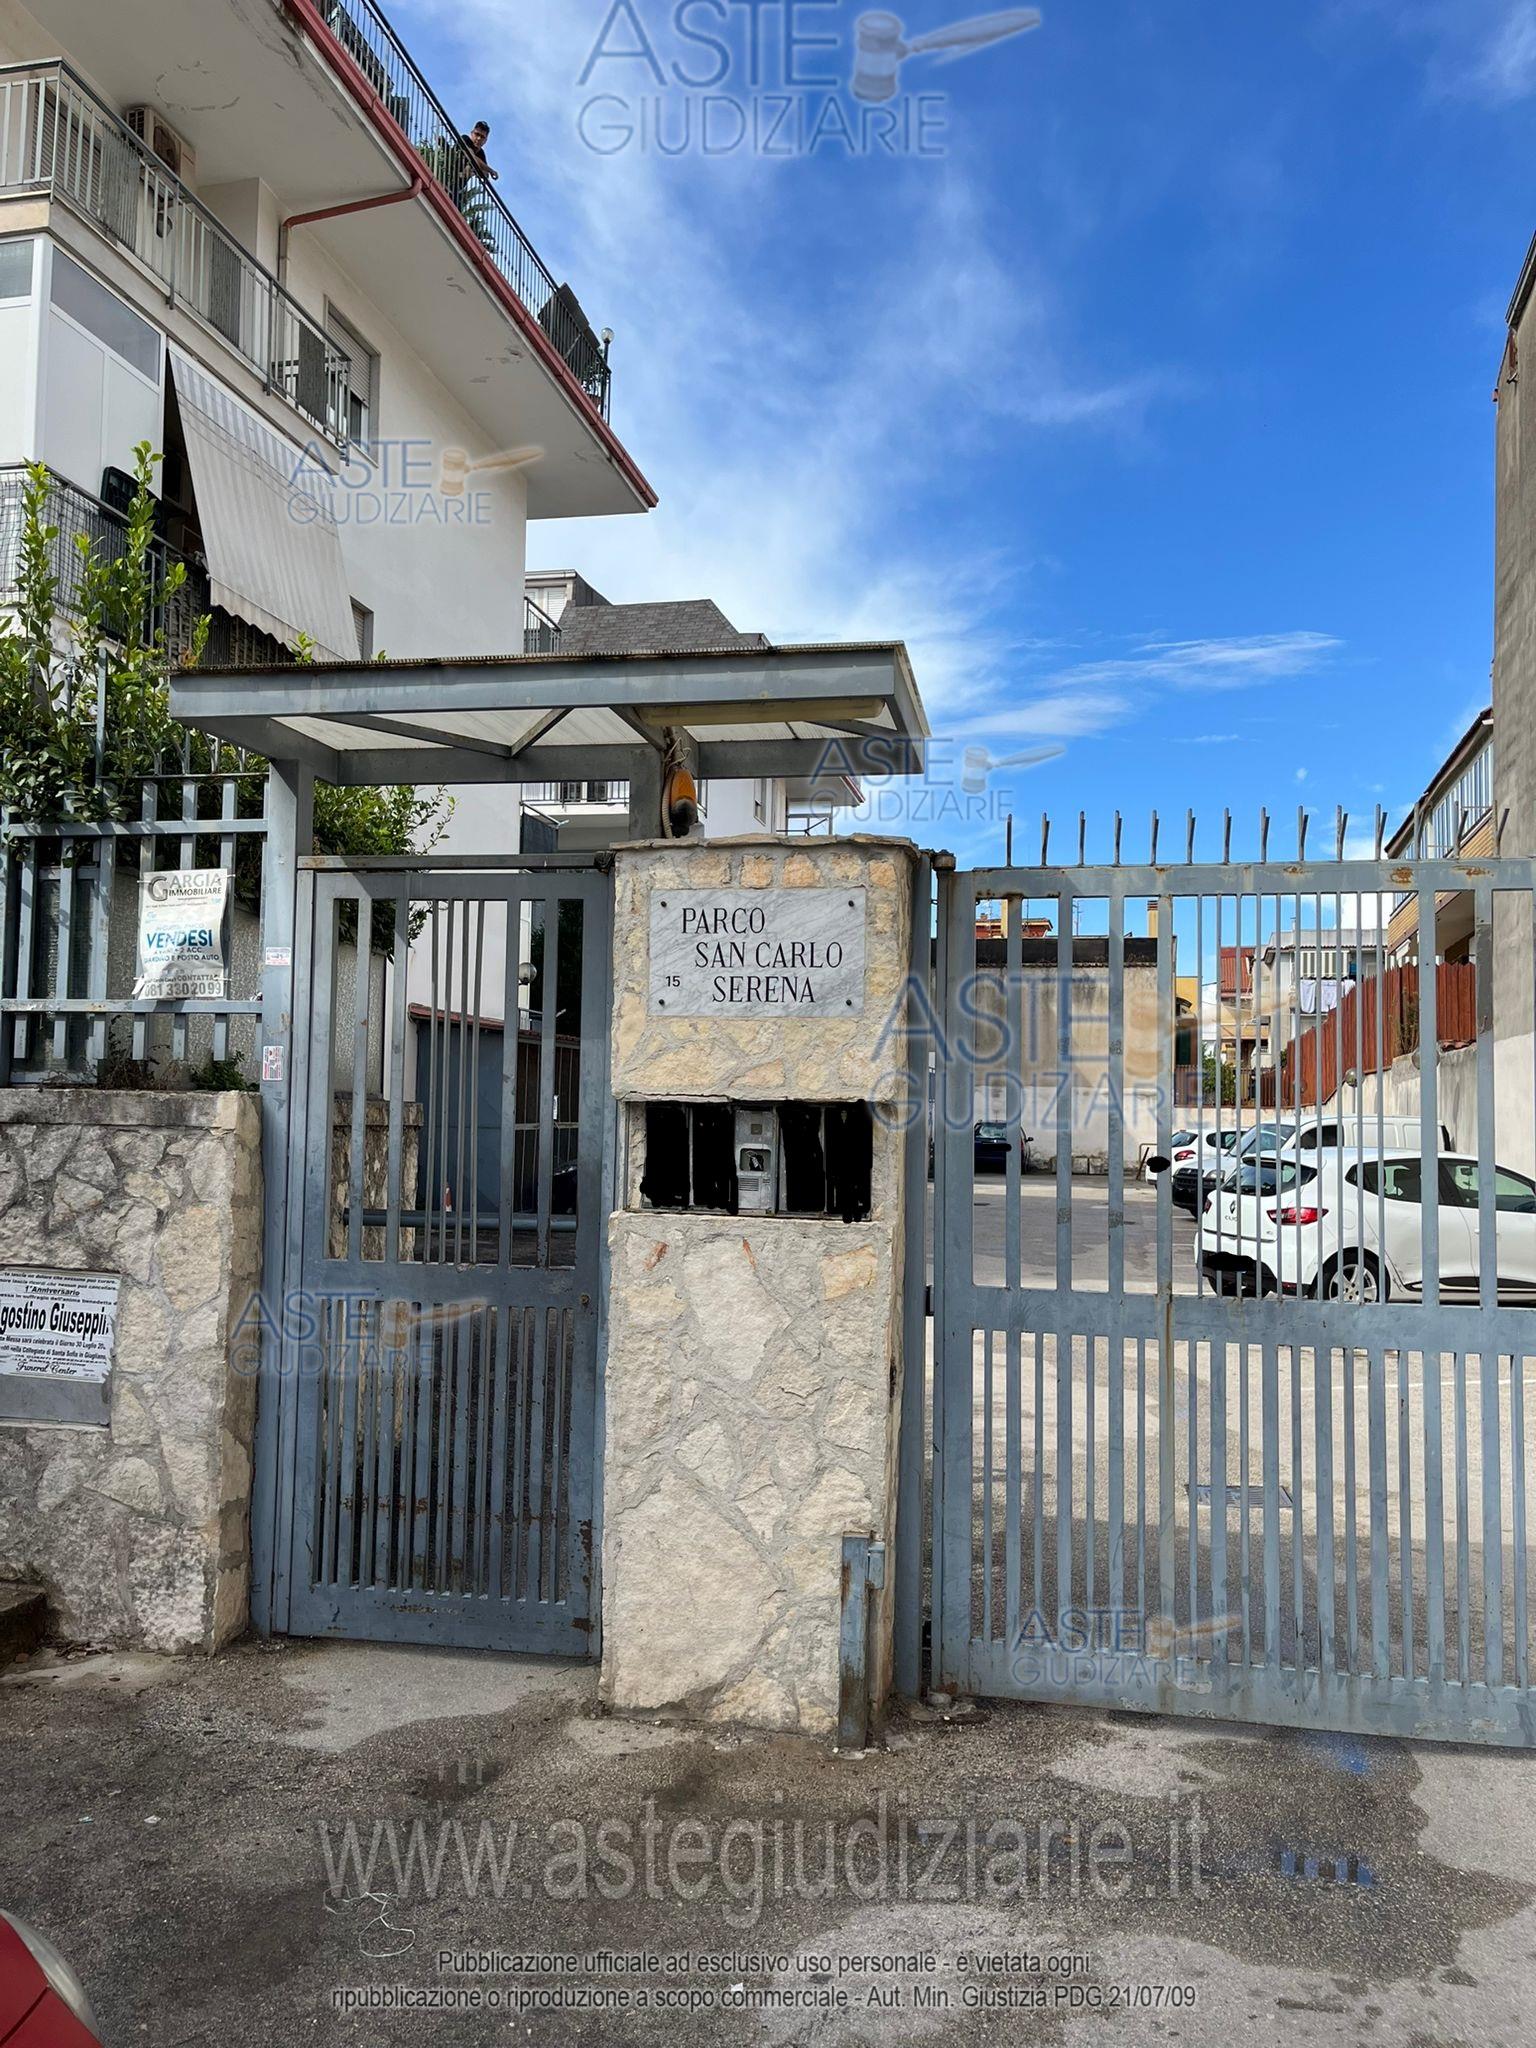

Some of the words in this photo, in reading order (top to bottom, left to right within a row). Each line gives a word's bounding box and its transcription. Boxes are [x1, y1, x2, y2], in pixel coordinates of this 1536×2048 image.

[168, 887, 222, 897] IMMOBILIARE
[682, 907, 766, 934] PARCO
[146, 929, 213, 949] VENDESI
[695, 942, 746, 968] SAN
[755, 942, 843, 968] CARLO
[665, 975, 681, 987] 15
[712, 976, 816, 1003] SERENA
[16, 1361, 48, 1373] Funeral
[50, 1364, 77, 1375] Center
